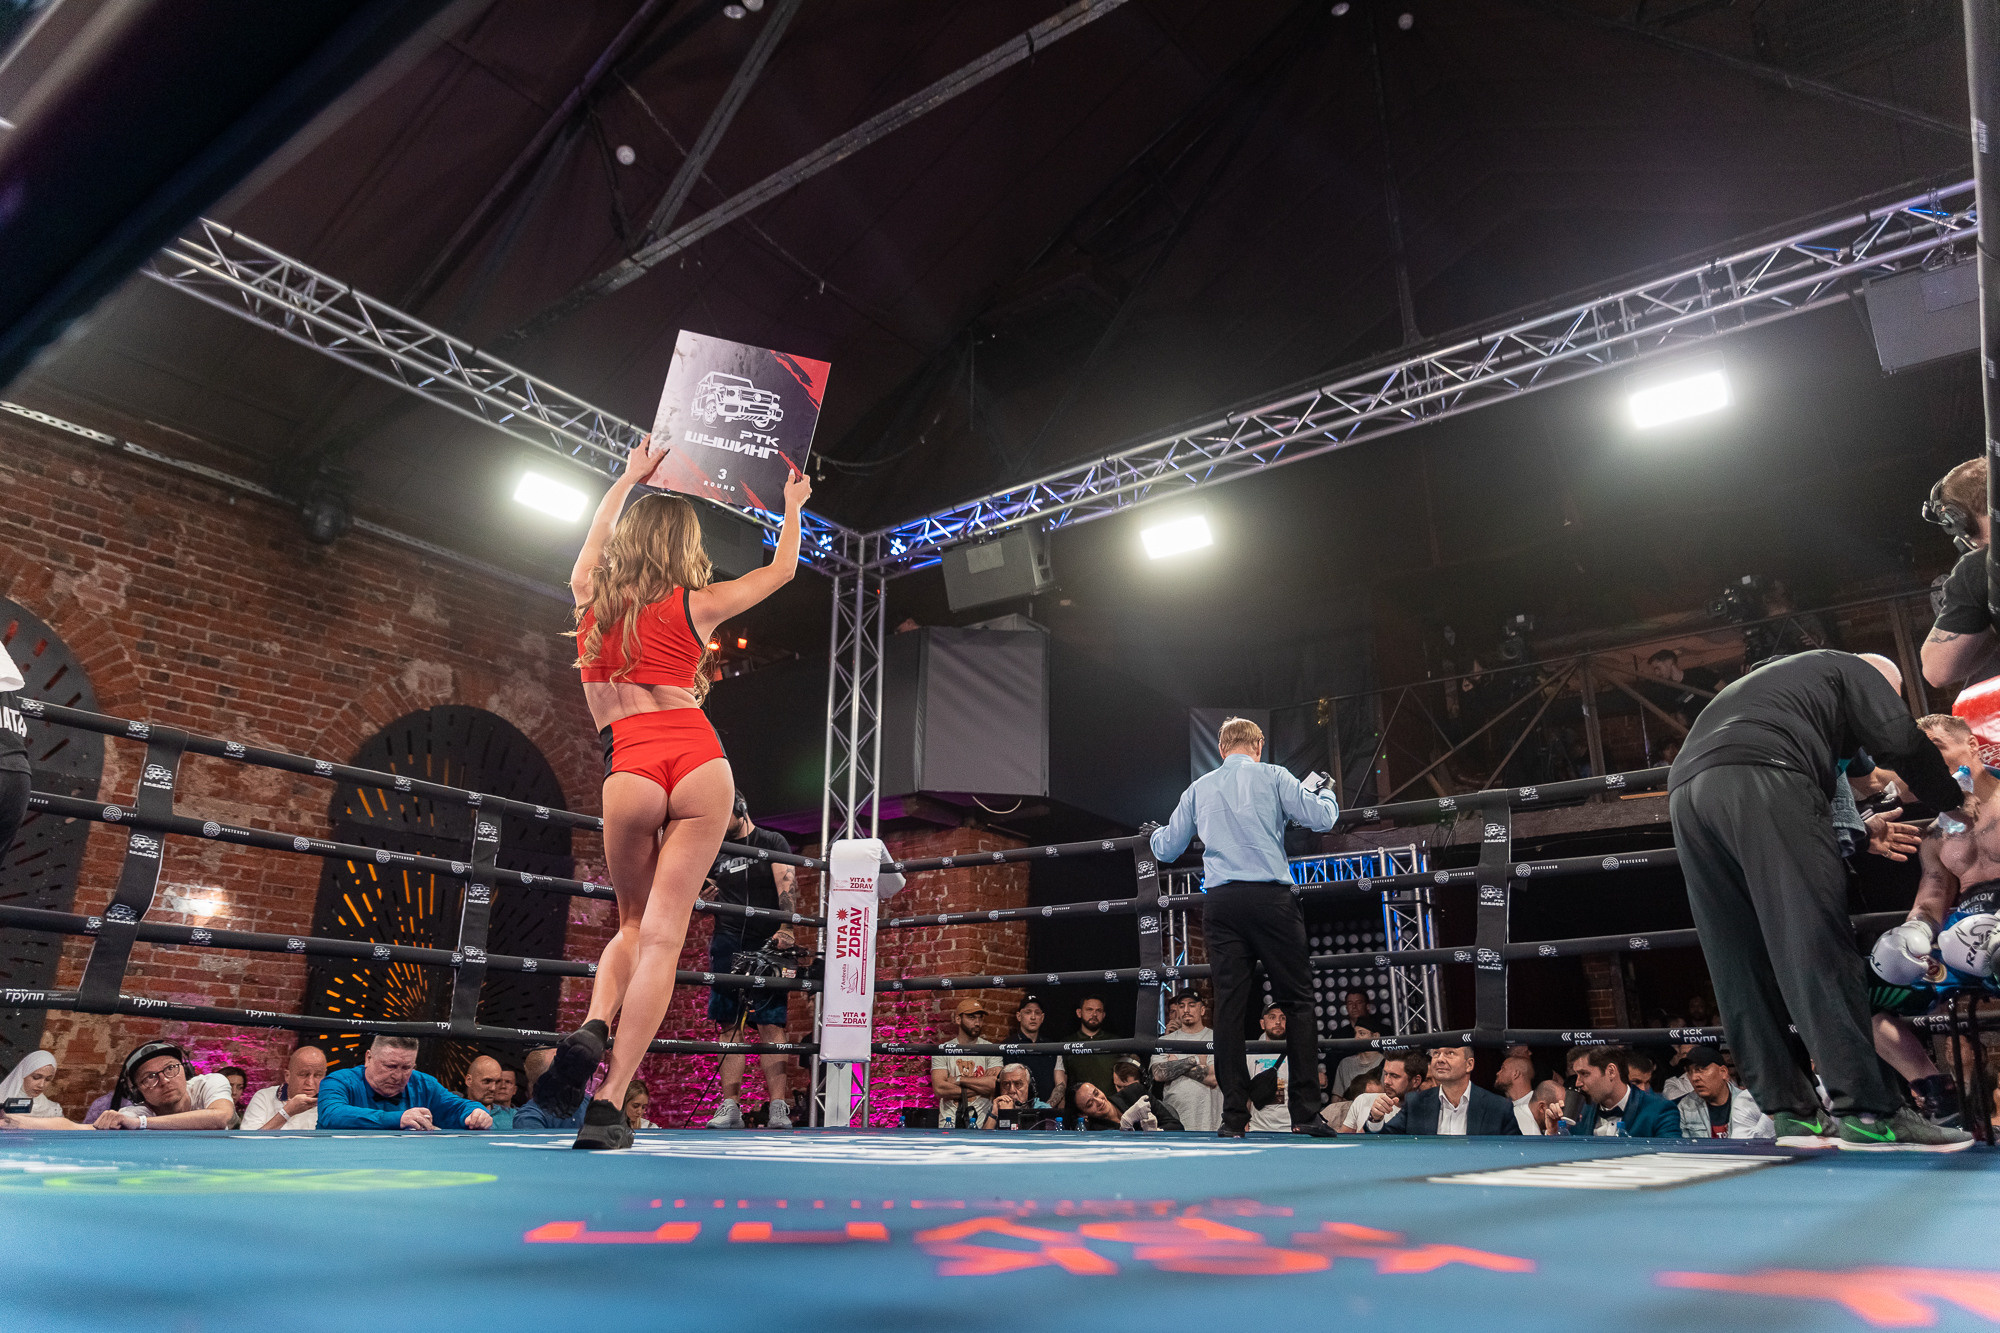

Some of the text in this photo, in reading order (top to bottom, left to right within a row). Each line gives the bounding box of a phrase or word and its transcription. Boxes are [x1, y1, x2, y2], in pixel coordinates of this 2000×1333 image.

[740, 430, 779, 447] РТК
[684, 430, 778, 460] ШУШИНГ
[717, 468, 728, 480] 3
[703, 480, 736, 492] ROUND
[1963, 904, 1985, 915] AVEL
[848, 906, 862, 958] ZDRAV
[836, 924, 848, 959] VITA
[5, 991, 45, 1003] групп
[133, 997, 168, 1009] групп
[842, 1017, 867, 1025] ZDRAV
[1574, 1031, 1592, 1039] КСК
[1683, 1028, 1703, 1036] КСК
[1382, 1038, 1398, 1046] КСК
